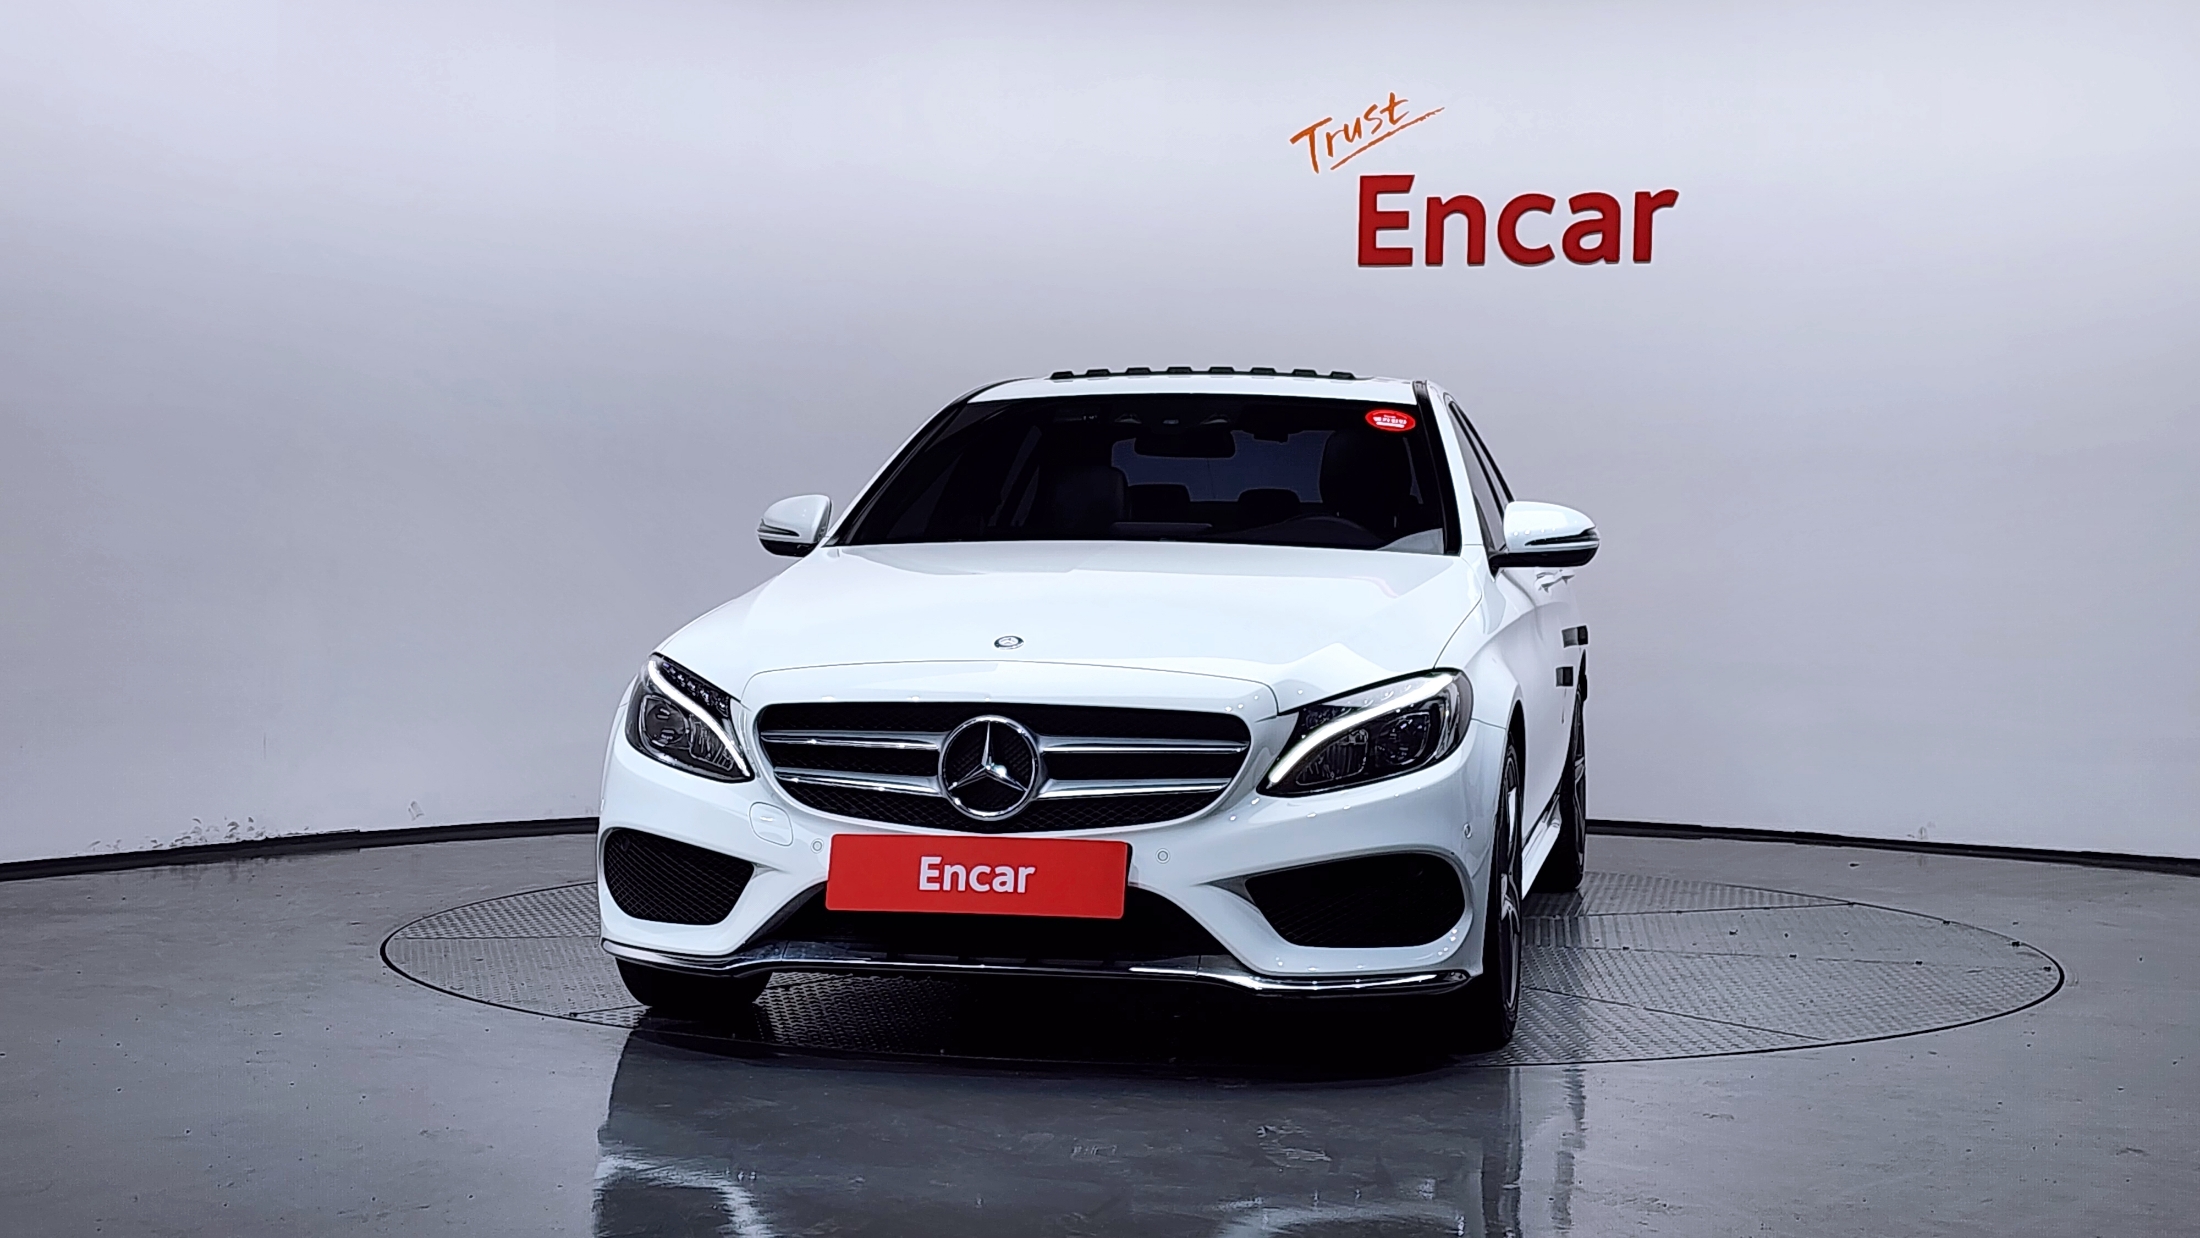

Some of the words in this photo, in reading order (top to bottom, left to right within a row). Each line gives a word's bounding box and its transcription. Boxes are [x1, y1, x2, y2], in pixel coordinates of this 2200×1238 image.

[1289, 92, 1409, 174] Trust
[1357, 174, 1680, 268] Encar
[918, 856, 1036, 894] Encar
